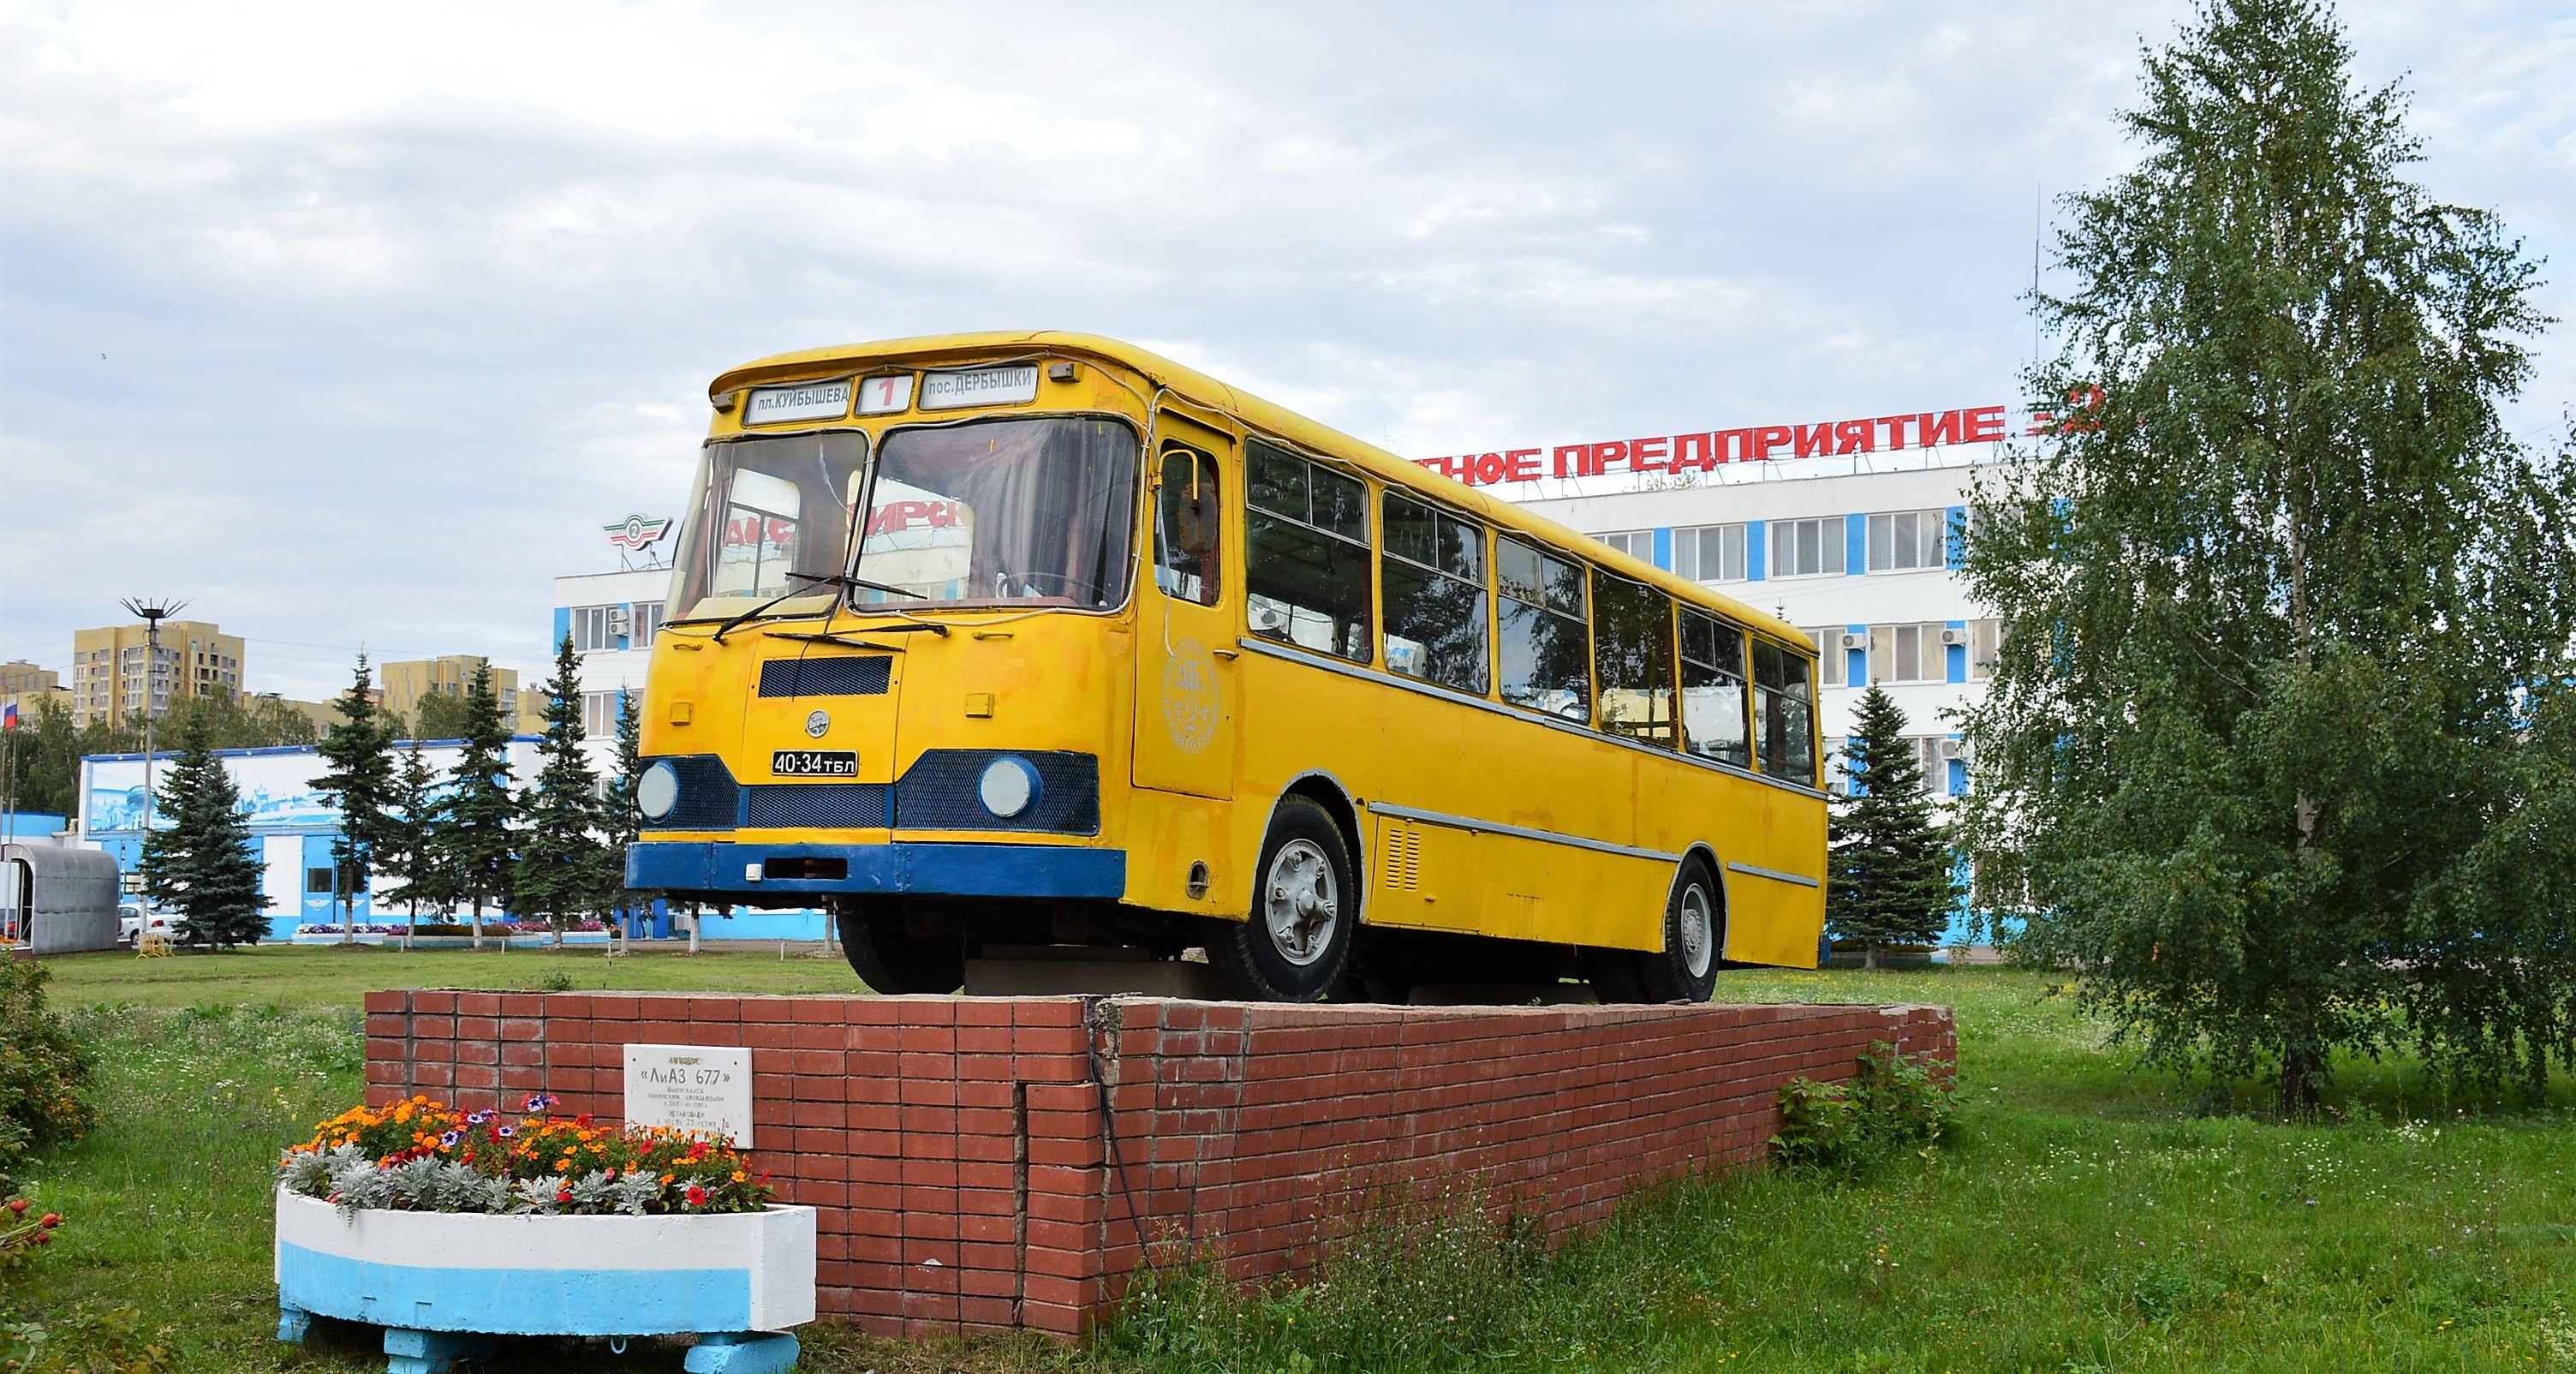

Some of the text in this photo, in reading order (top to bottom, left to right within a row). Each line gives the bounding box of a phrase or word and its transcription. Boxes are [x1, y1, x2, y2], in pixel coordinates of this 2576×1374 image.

[878, 377, 895, 407] 1
[928, 369, 1032, 395] пос.ДЕРБЫШКИ
[1553, 404, 2006, 479] ПРЕДПРИЯТИЕ
